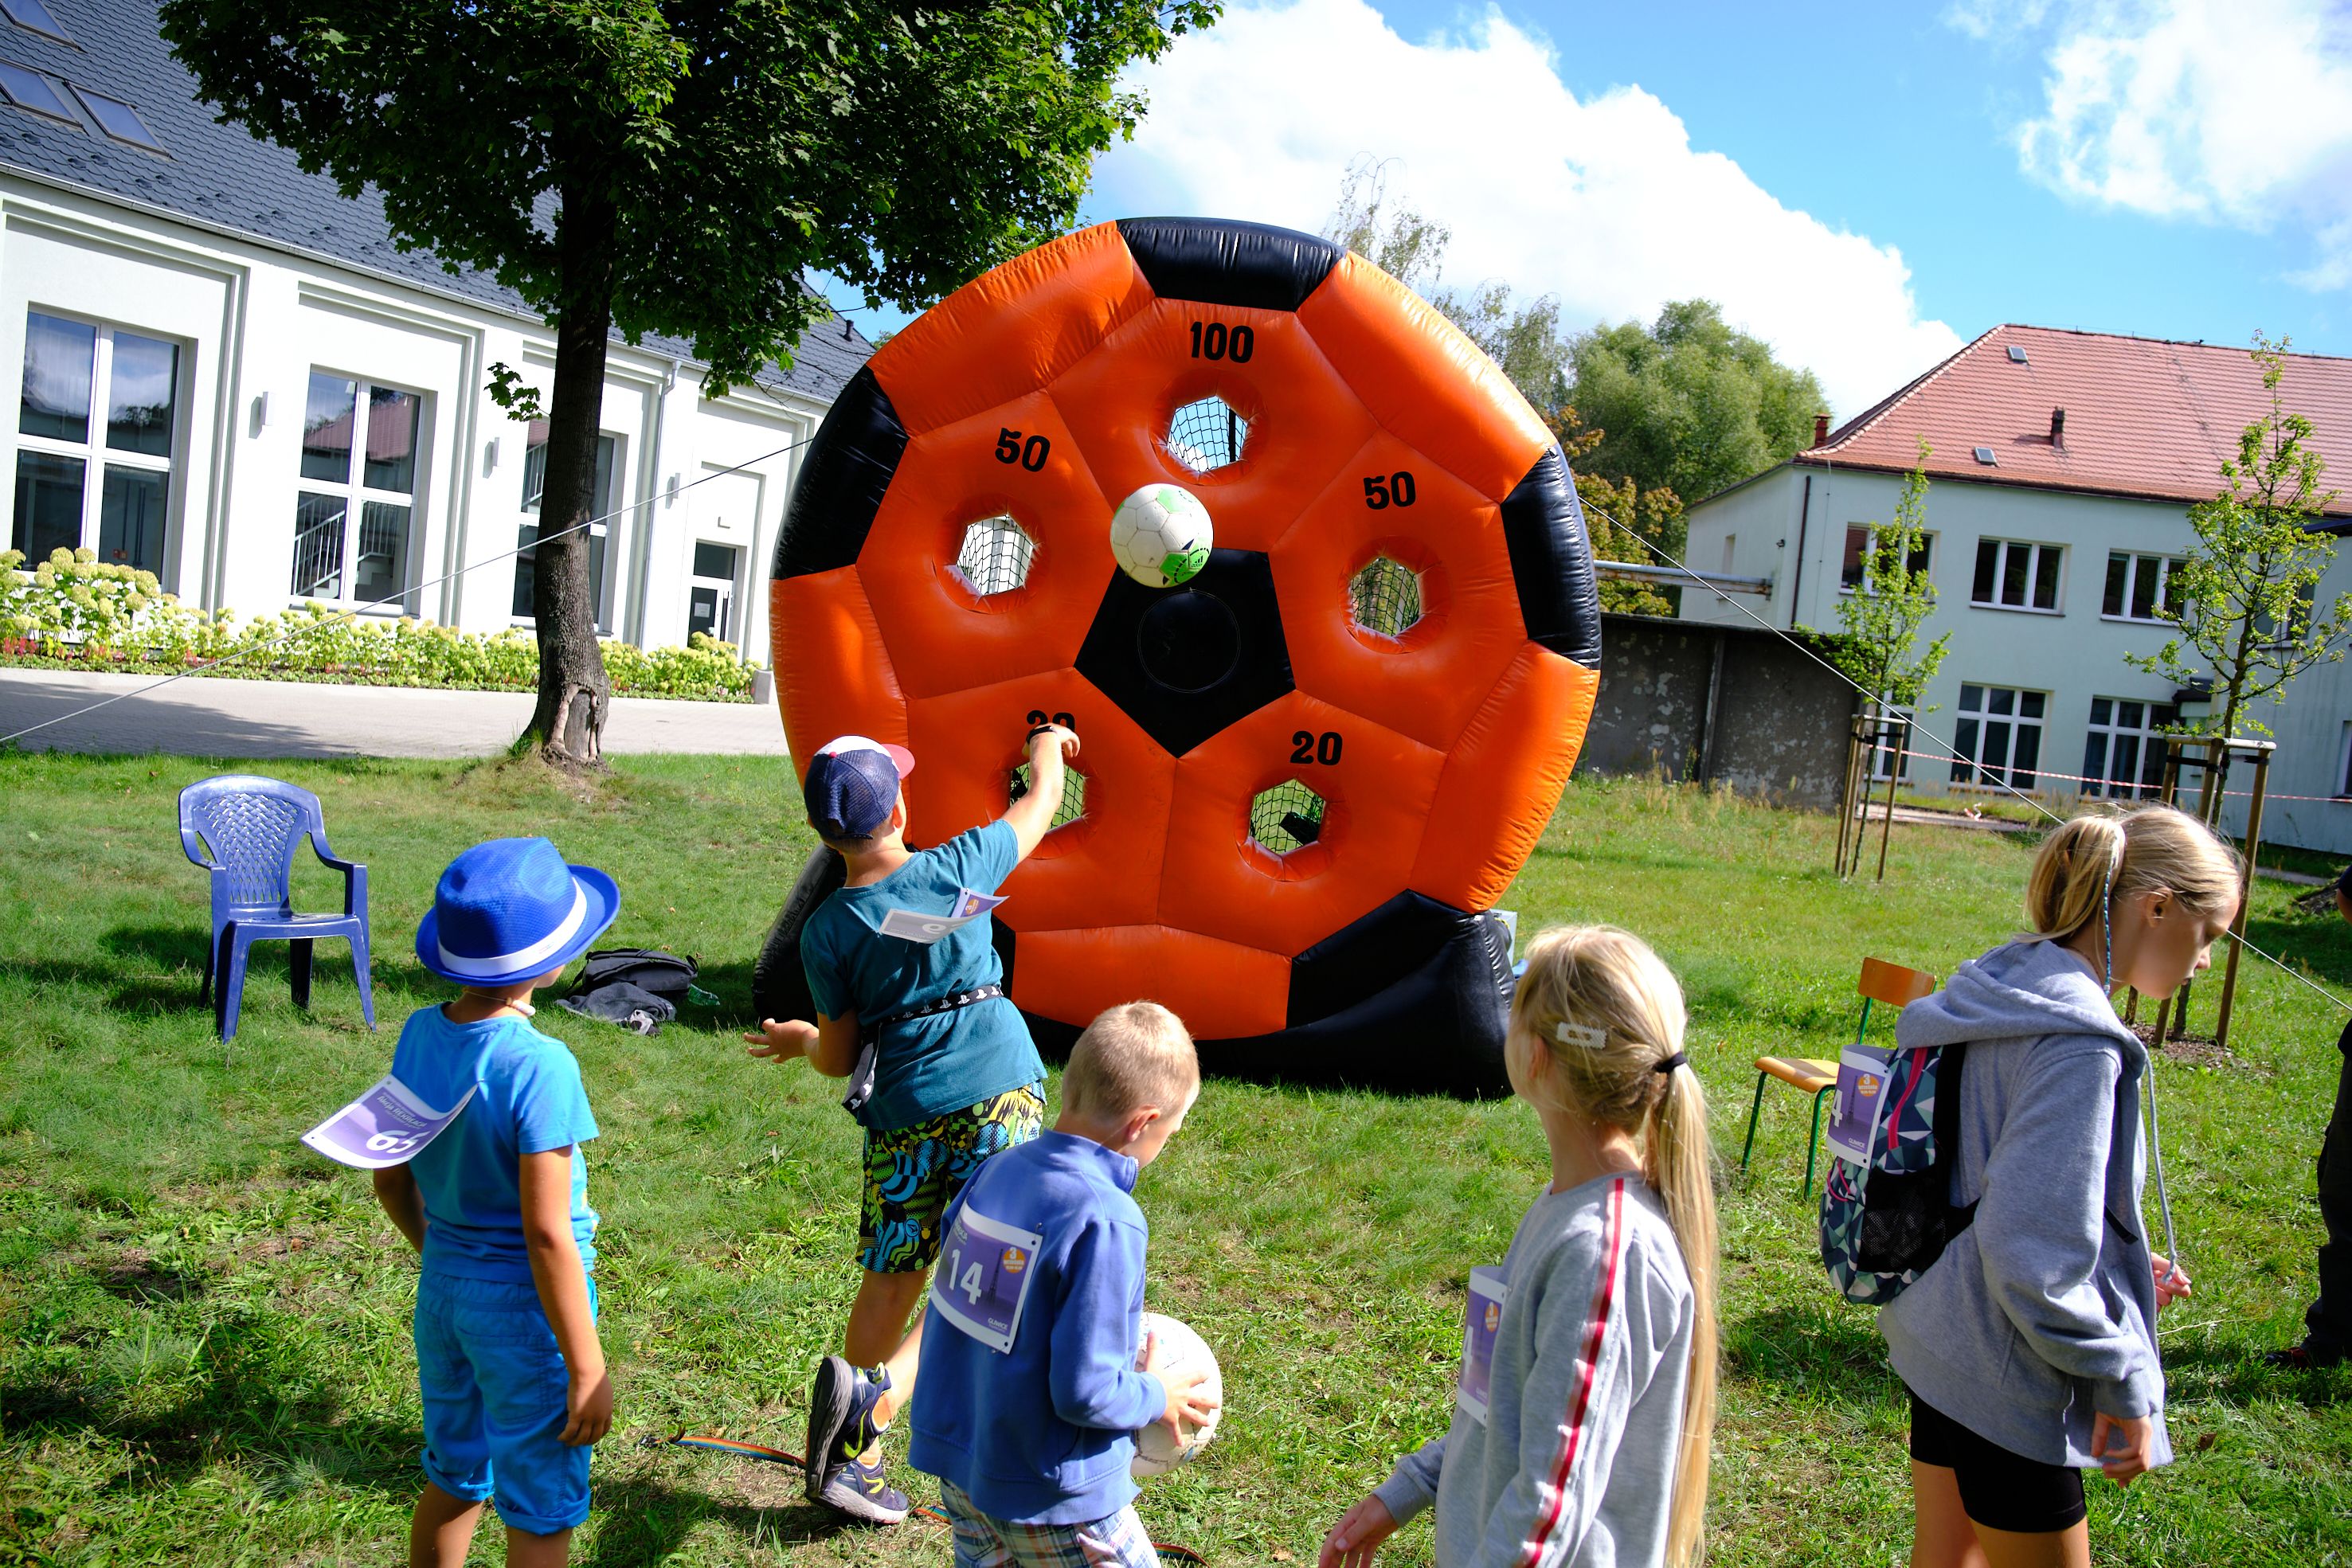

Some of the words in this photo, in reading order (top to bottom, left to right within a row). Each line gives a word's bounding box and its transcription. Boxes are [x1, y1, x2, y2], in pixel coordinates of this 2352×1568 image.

[1190, 321, 1254, 364] 100
[995, 428, 1051, 472] 50
[1363, 471, 1417, 510] 50
[1290, 730, 1344, 766] 20
[1863, 1073, 1871, 1085] 3
[1831, 1089, 1843, 1128] 4
[366, 1129, 432, 1154] 65
[1009, 1246, 1017, 1259] 3
[949, 1248, 984, 1305] 14
